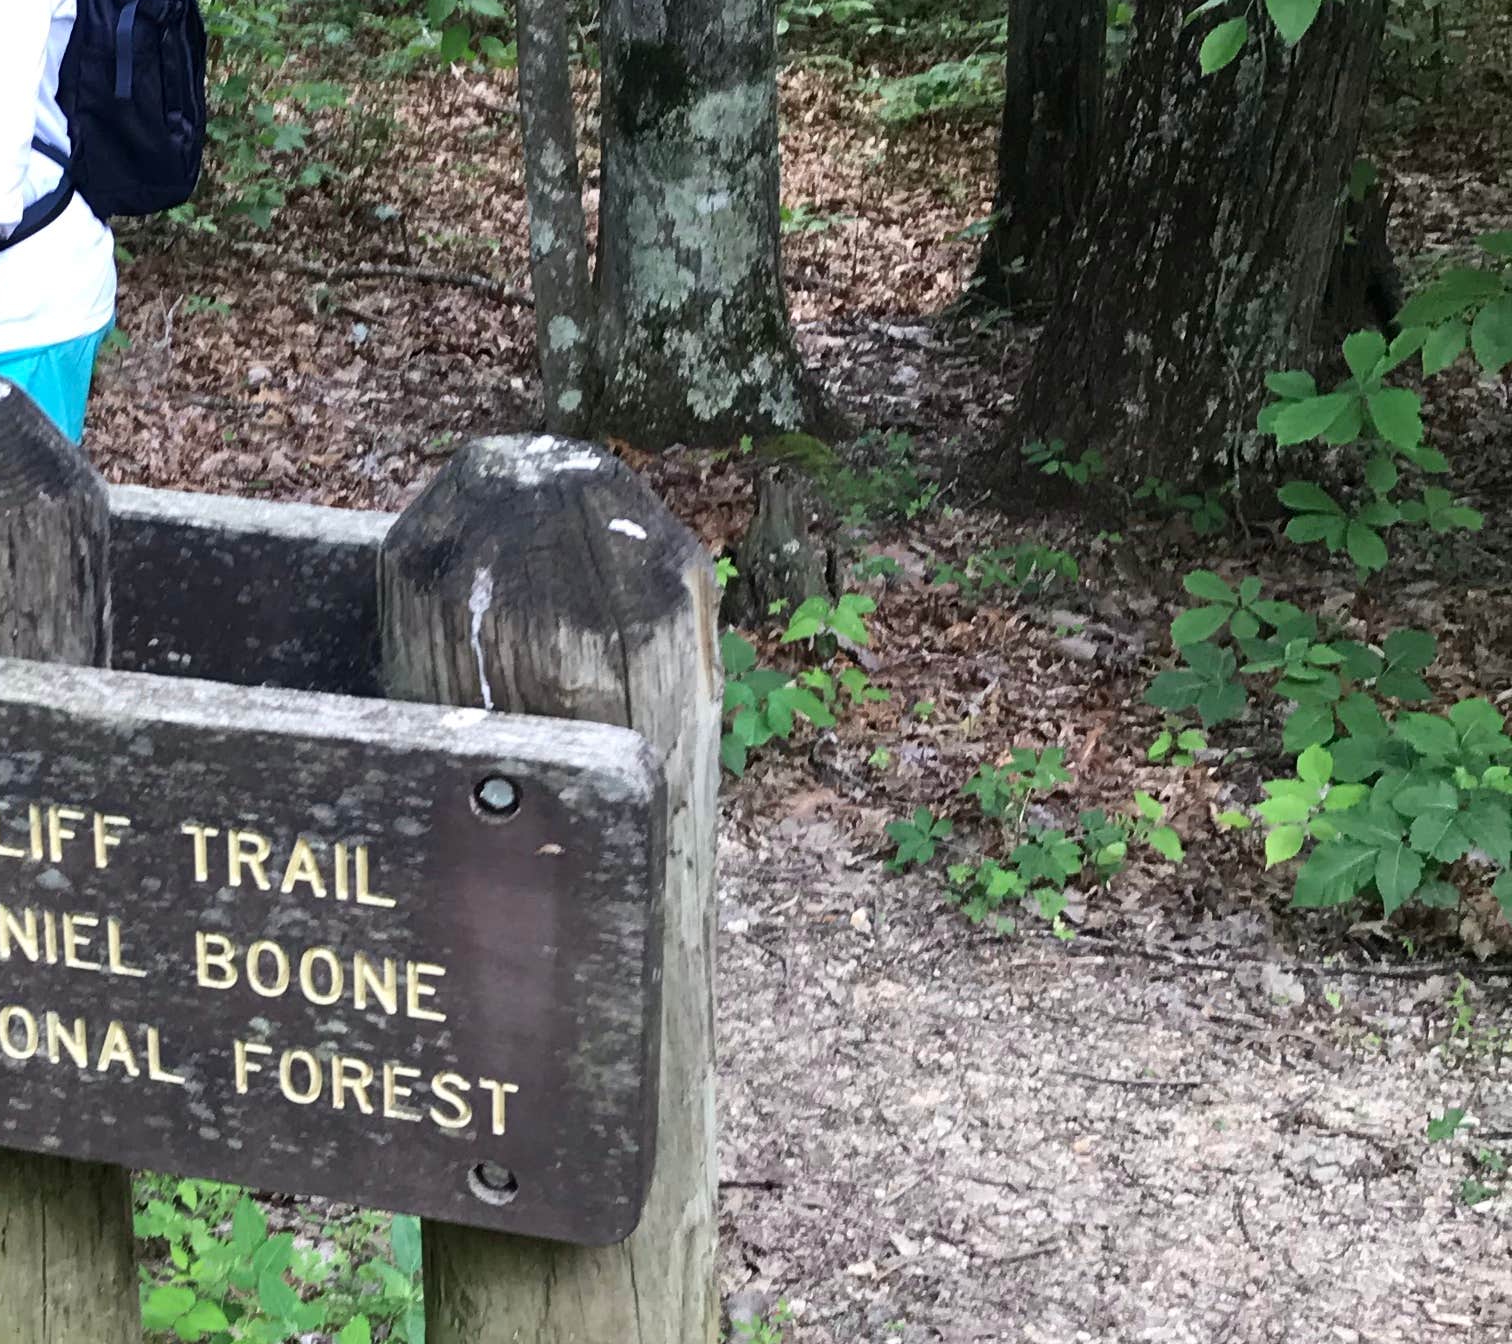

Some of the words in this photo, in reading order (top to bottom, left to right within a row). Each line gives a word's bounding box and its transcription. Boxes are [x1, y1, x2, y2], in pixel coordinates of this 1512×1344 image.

[181, 822, 397, 908] TRAIL
[195, 930, 447, 1023] BOONE
[234, 1039, 520, 1136] FOREST
